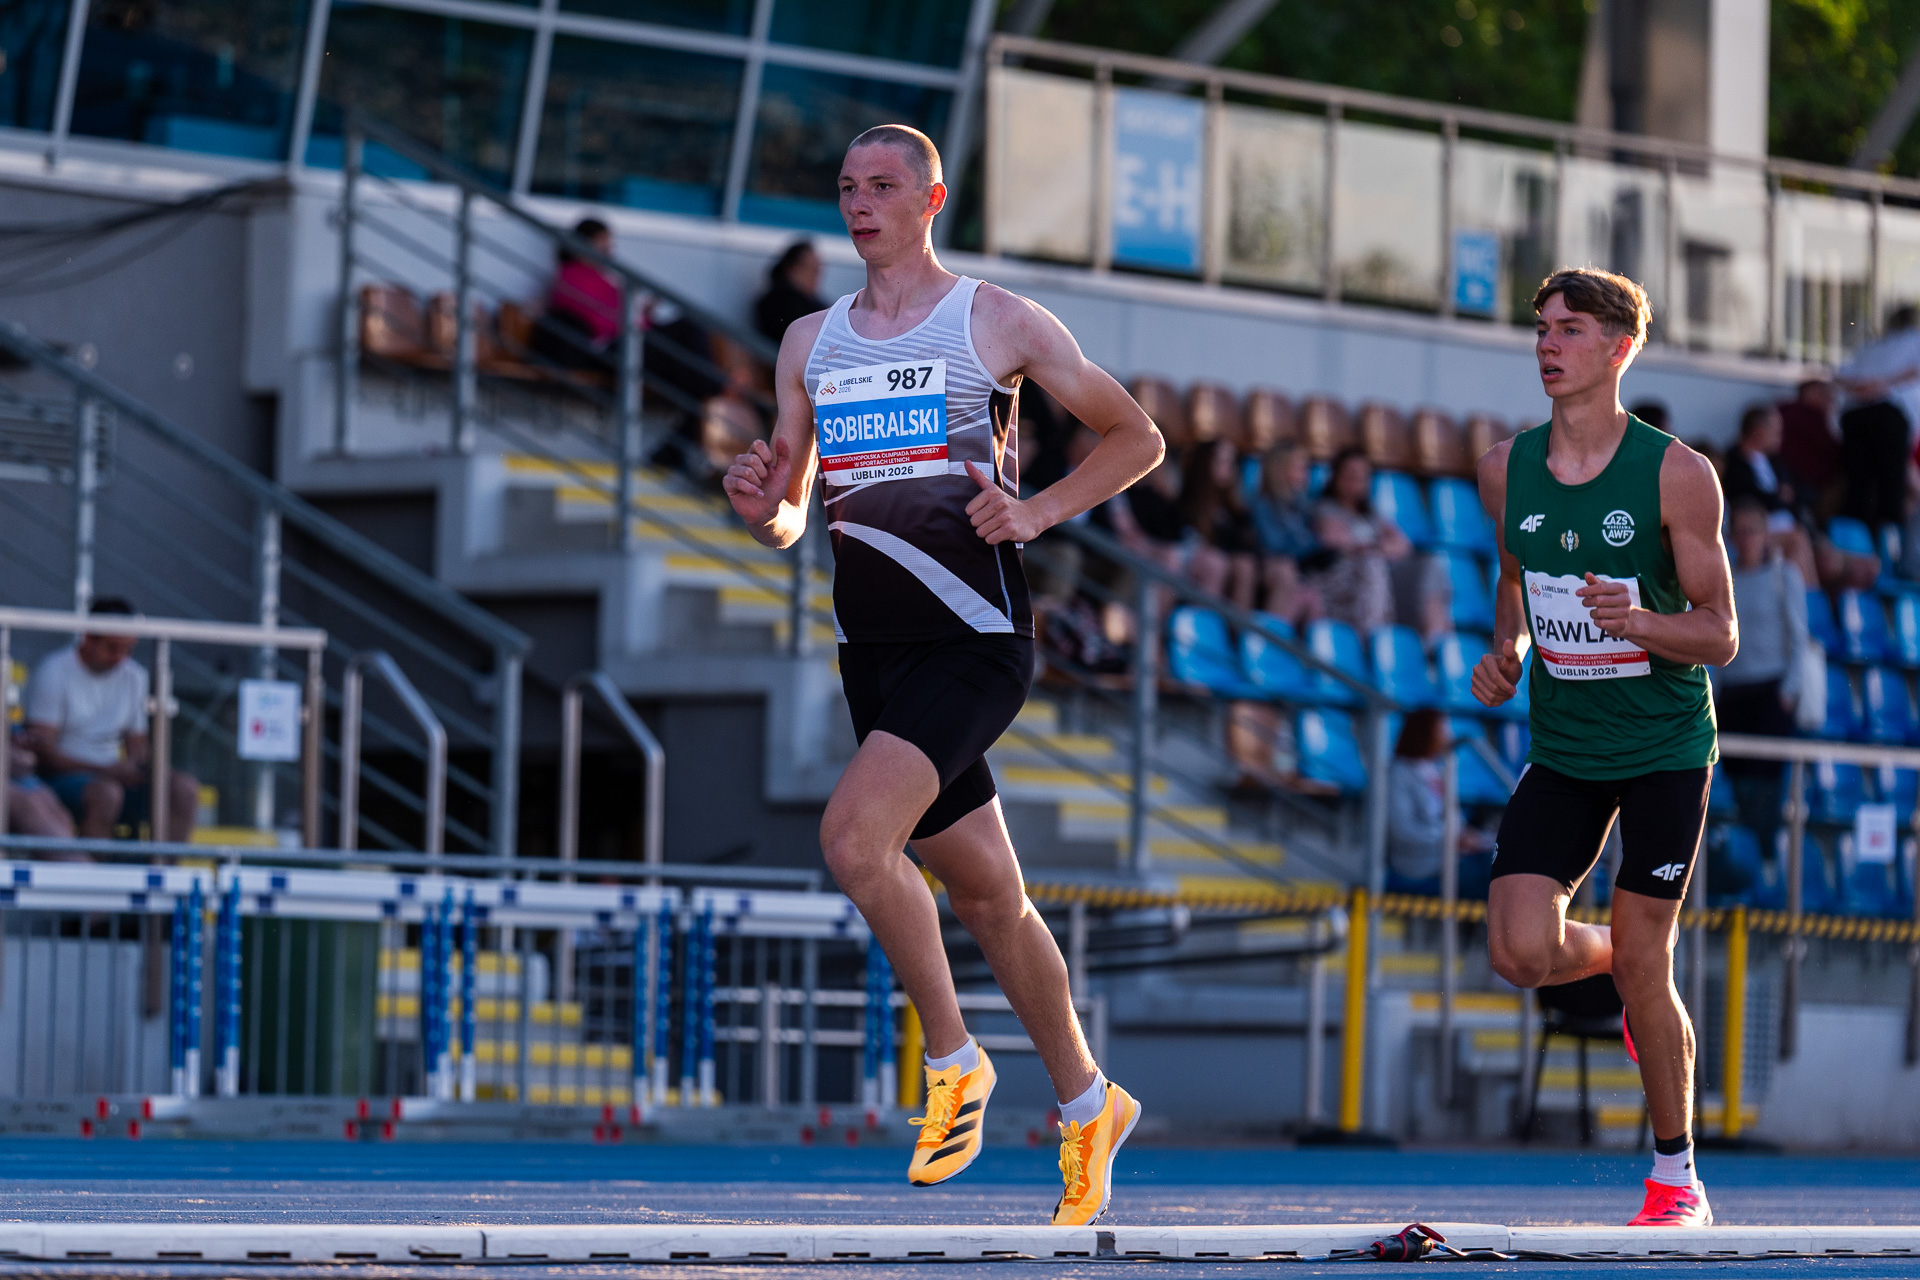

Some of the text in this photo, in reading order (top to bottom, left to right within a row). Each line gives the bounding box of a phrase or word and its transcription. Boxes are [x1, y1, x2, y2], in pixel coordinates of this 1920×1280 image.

[839, 375, 873, 387] LUBELSKIE
[887, 366, 933, 392] 987
[823, 408, 939, 445] SOBIERALSKI
[842, 453, 881, 463] OGÓLNOPOLSKA
[881, 450, 909, 459] OLIMPIADA
[910, 447, 940, 456] MŁODZIEŻY
[860, 459, 888, 467] SPORTACH
[851, 466, 914, 481] LUBLIN 2026
[1520, 514, 1545, 533] 4F
[1610, 515, 1628, 526] AZS
[1608, 529, 1629, 539] AWF
[1556, 666, 1618, 676] LUBLIN 2026
[1652, 863, 1686, 881] 4F
